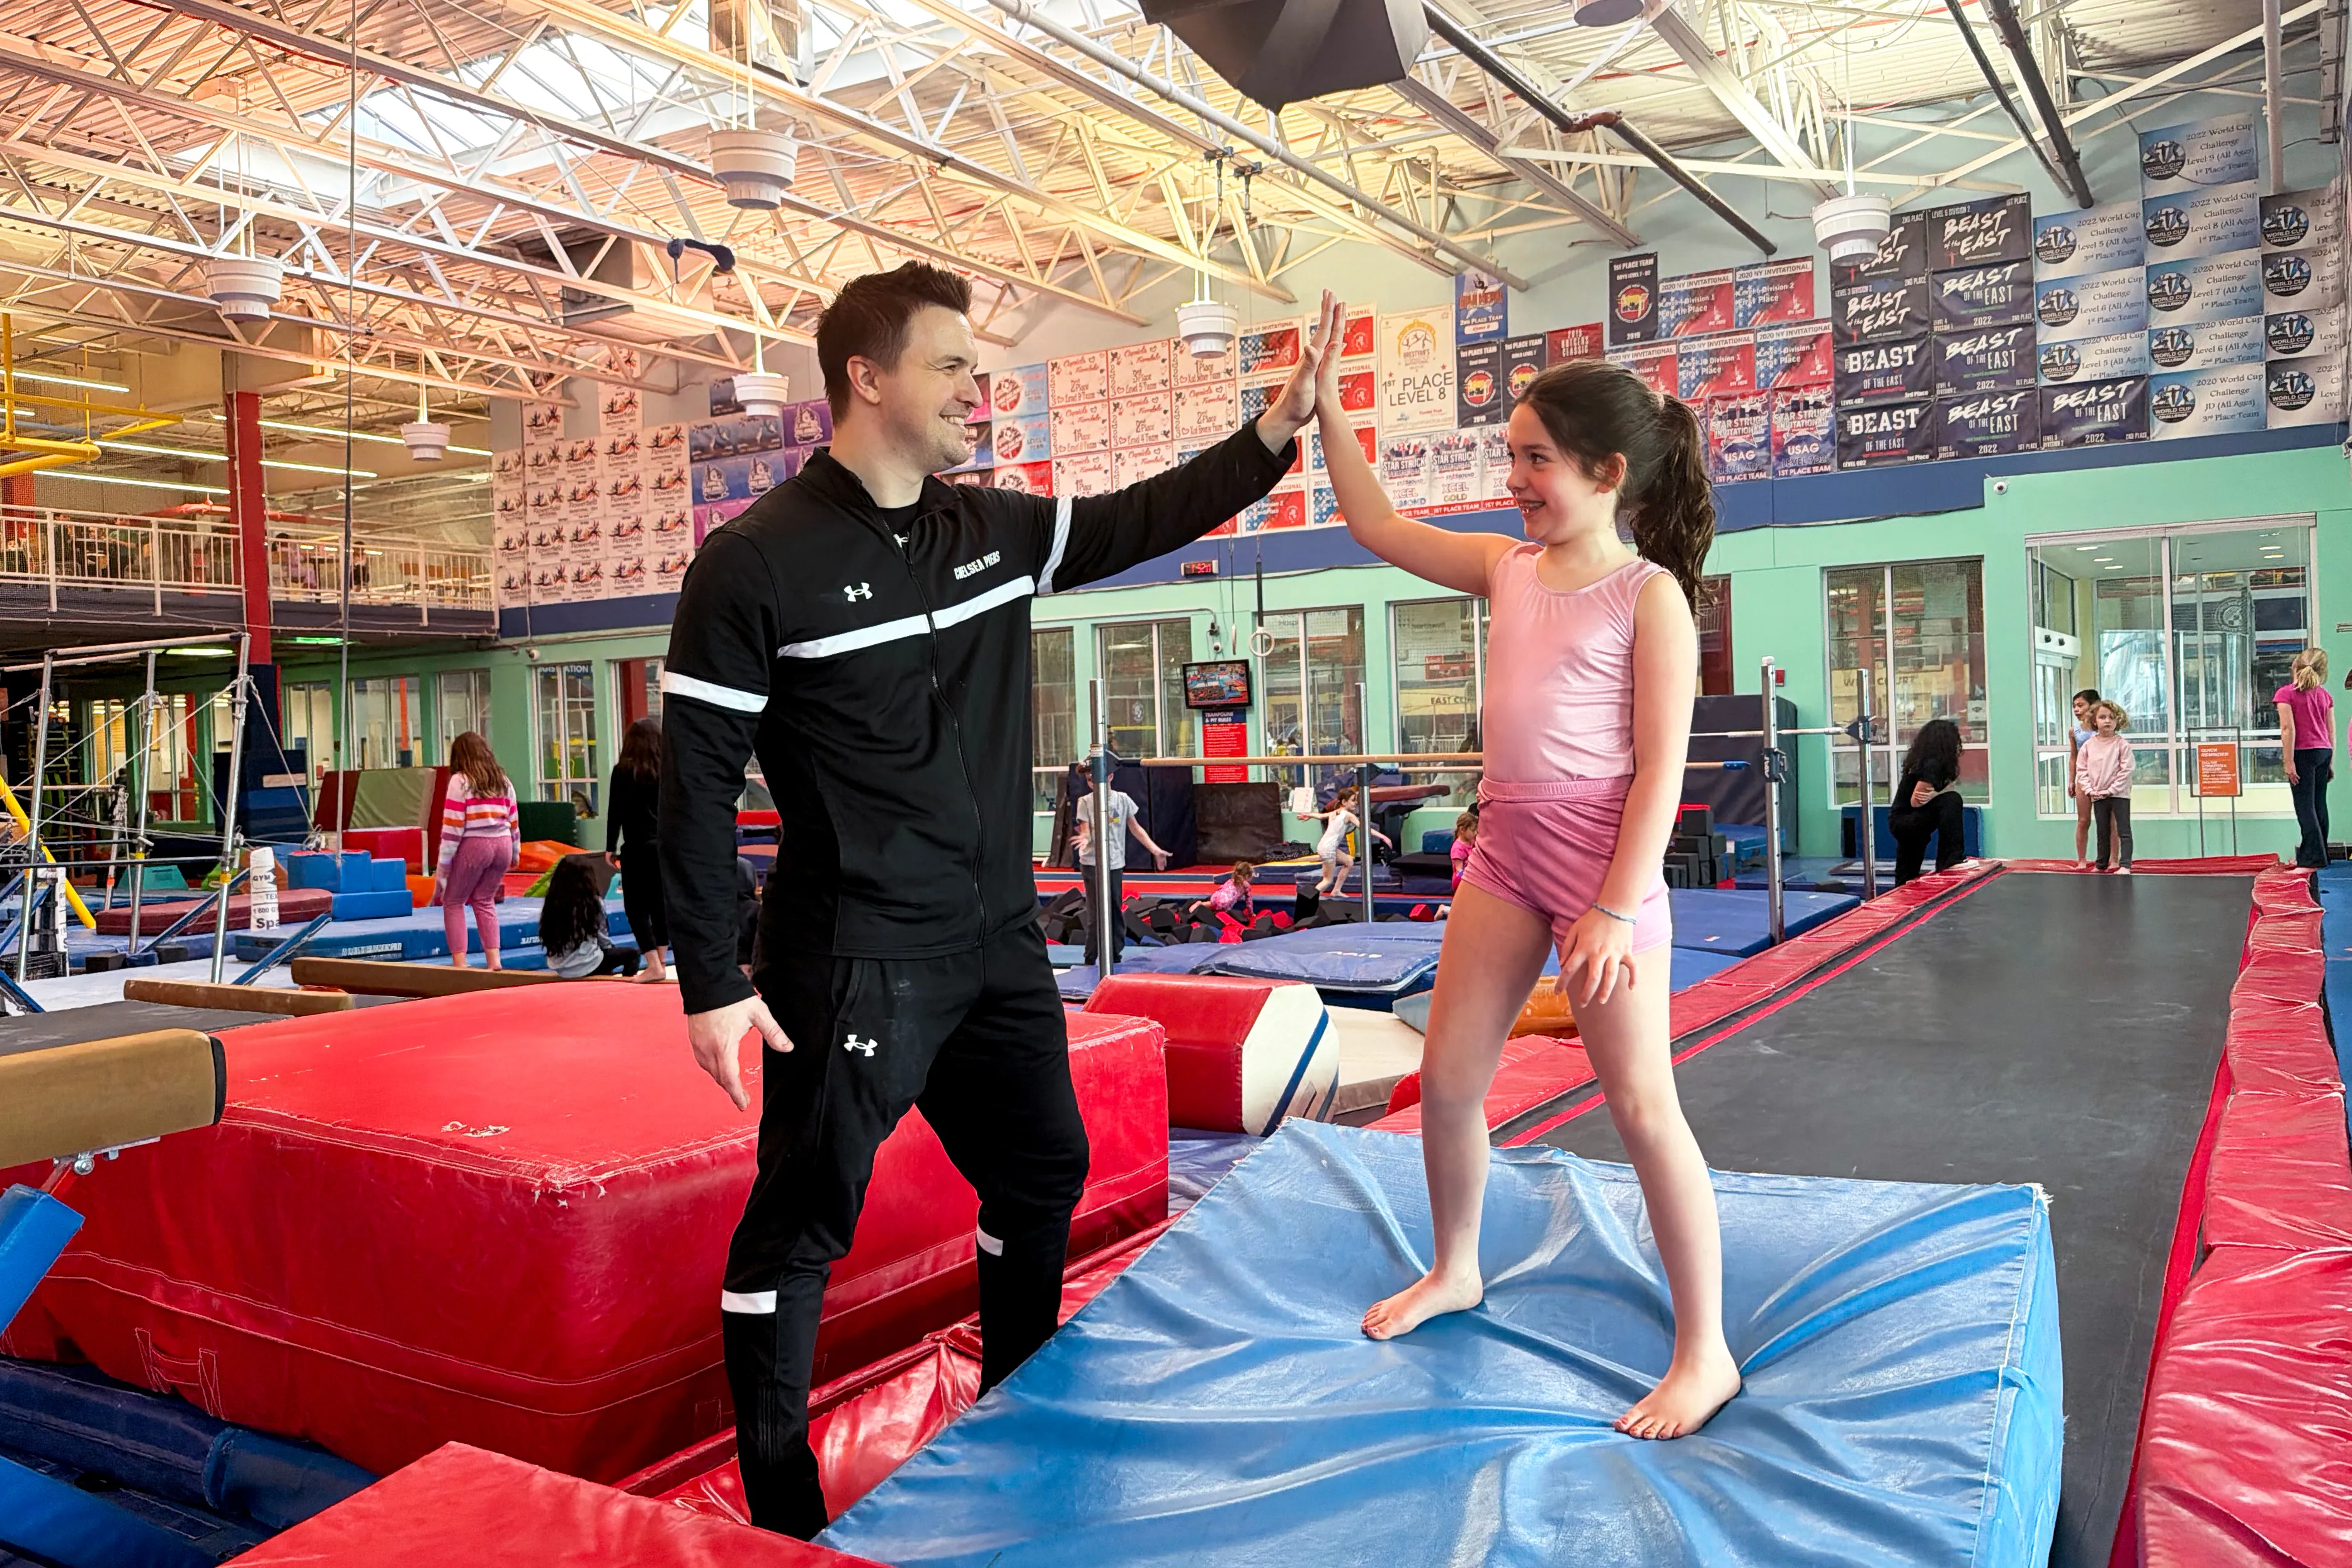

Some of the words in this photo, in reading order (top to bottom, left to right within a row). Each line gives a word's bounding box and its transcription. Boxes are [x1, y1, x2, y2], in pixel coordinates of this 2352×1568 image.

[2209, 125, 2234, 135] World
[2189, 199, 2210, 208] 2022
[2213, 194, 2238, 204] World
[2241, 191, 2258, 200] Cup
[2204, 207, 2244, 218] Challenge
[1943, 209, 2007, 242] BEAST
[2077, 219, 2097, 227] 2022
[2099, 213, 2123, 223] World
[2125, 212, 2141, 220] Cup
[2090, 226, 2128, 237] Challenge
[1960, 228, 2011, 256] EAST
[1622, 261, 1638, 270] PLACE
[1639, 258, 1654, 267] TEAM
[1764, 264, 1810, 275] INVITATIONAL
[2193, 265, 2214, 273] 2020
[2216, 261, 2241, 270] World
[2243, 259, 2260, 268] Cup
[1661, 283, 1676, 291] 2020
[1686, 275, 1731, 287] INVITATIONAL
[1942, 263, 2019, 297] BEAST
[2080, 282, 2099, 290] 2022
[2101, 278, 2125, 287] World
[2127, 276, 2144, 285] Cup
[2206, 273, 2247, 284] Challenge
[1963, 292, 1970, 302] OF
[1973, 290, 1983, 300] THE
[1985, 285, 2013, 305] EAST
[2092, 290, 2130, 300] Challenge
[1846, 289, 1907, 320] BEAST
[1862, 307, 1911, 334] EAST
[1973, 316, 1992, 326] 2022
[2195, 322, 2216, 330] 2020
[2218, 317, 2244, 327] World
[1626, 332, 1641, 340] 2019
[1786, 326, 1831, 336] INVITATIONAL
[2208, 330, 2249, 341] Challenge
[1561, 336, 1589, 349] RUTGERS
[1707, 336, 1751, 348] INVITATIONAL
[2103, 334, 2127, 343] World
[2129, 332, 2145, 340] Cup
[1944, 327, 2023, 361] BEAST
[1562, 345, 1588, 357] CLASSIC
[1631, 348, 1674, 358] INVITATIONAL
[2094, 346, 2132, 356] Challenge
[1710, 355, 1735, 363] Division
[1847, 344, 1917, 373] BEAST
[1967, 355, 1973, 365] OF
[1976, 353, 1986, 363] THE
[1988, 349, 2016, 370] EAST
[1382, 380, 1396, 394] 1ST
[1403, 372, 1453, 391] PLACE
[1863, 379, 1871, 389] OF
[1873, 377, 1884, 389] THE
[1887, 374, 1903, 387] EAST
[1976, 380, 1995, 390] 2022
[2196, 378, 2217, 386] 2020
[2219, 374, 2244, 383] World
[2246, 373, 2263, 381] Cup
[1390, 389, 1434, 406] LEVEL
[1439, 387, 1446, 400] 8
[2052, 380, 2134, 412] BEAST
[2210, 387, 2250, 397] Challenge
[1947, 392, 2025, 425] BEAST
[2075, 408, 2082, 418] OF
[2085, 406, 2096, 416] THE
[2098, 402, 2127, 423] EAST
[1774, 412, 1796, 421] STAR
[1850, 407, 1919, 435] BEAST
[1711, 420, 1733, 429] STAR
[1968, 419, 1976, 429] OF
[1978, 417, 1989, 428] THE
[1990, 414, 2019, 433] EAST
[2085, 433, 2105, 443] 2022
[1788, 443, 1820, 455] USAG
[1865, 442, 1873, 452] OF
[1875, 440, 1887, 450] THE
[1888, 437, 1905, 450] EAST
[1978, 444, 1997, 454] 2022
[1432, 455, 1449, 465] STAR
[1450, 450, 1476, 462] STRUCK
[1484, 448, 1502, 458] STAR
[1725, 450, 1755, 463] USAG
[1383, 461, 1399, 472] STAR
[1400, 457, 1425, 469] STRUCK
[1727, 474, 1747, 482] PLACE
[1748, 472, 1767, 480] TEAM
[1778, 469, 1789, 477] 1ST
[1790, 467, 1810, 475] PLACE
[1812, 465, 1831, 473] TEAM
[1393, 488, 1419, 499] XCEL
[1442, 482, 1469, 494] XCEL
[1444, 493, 1468, 502] GOLD
[1434, 506, 1442, 514] 1ST
[954, 559, 985, 580] CHELSEA
[983, 550, 1000, 568] PIERS
